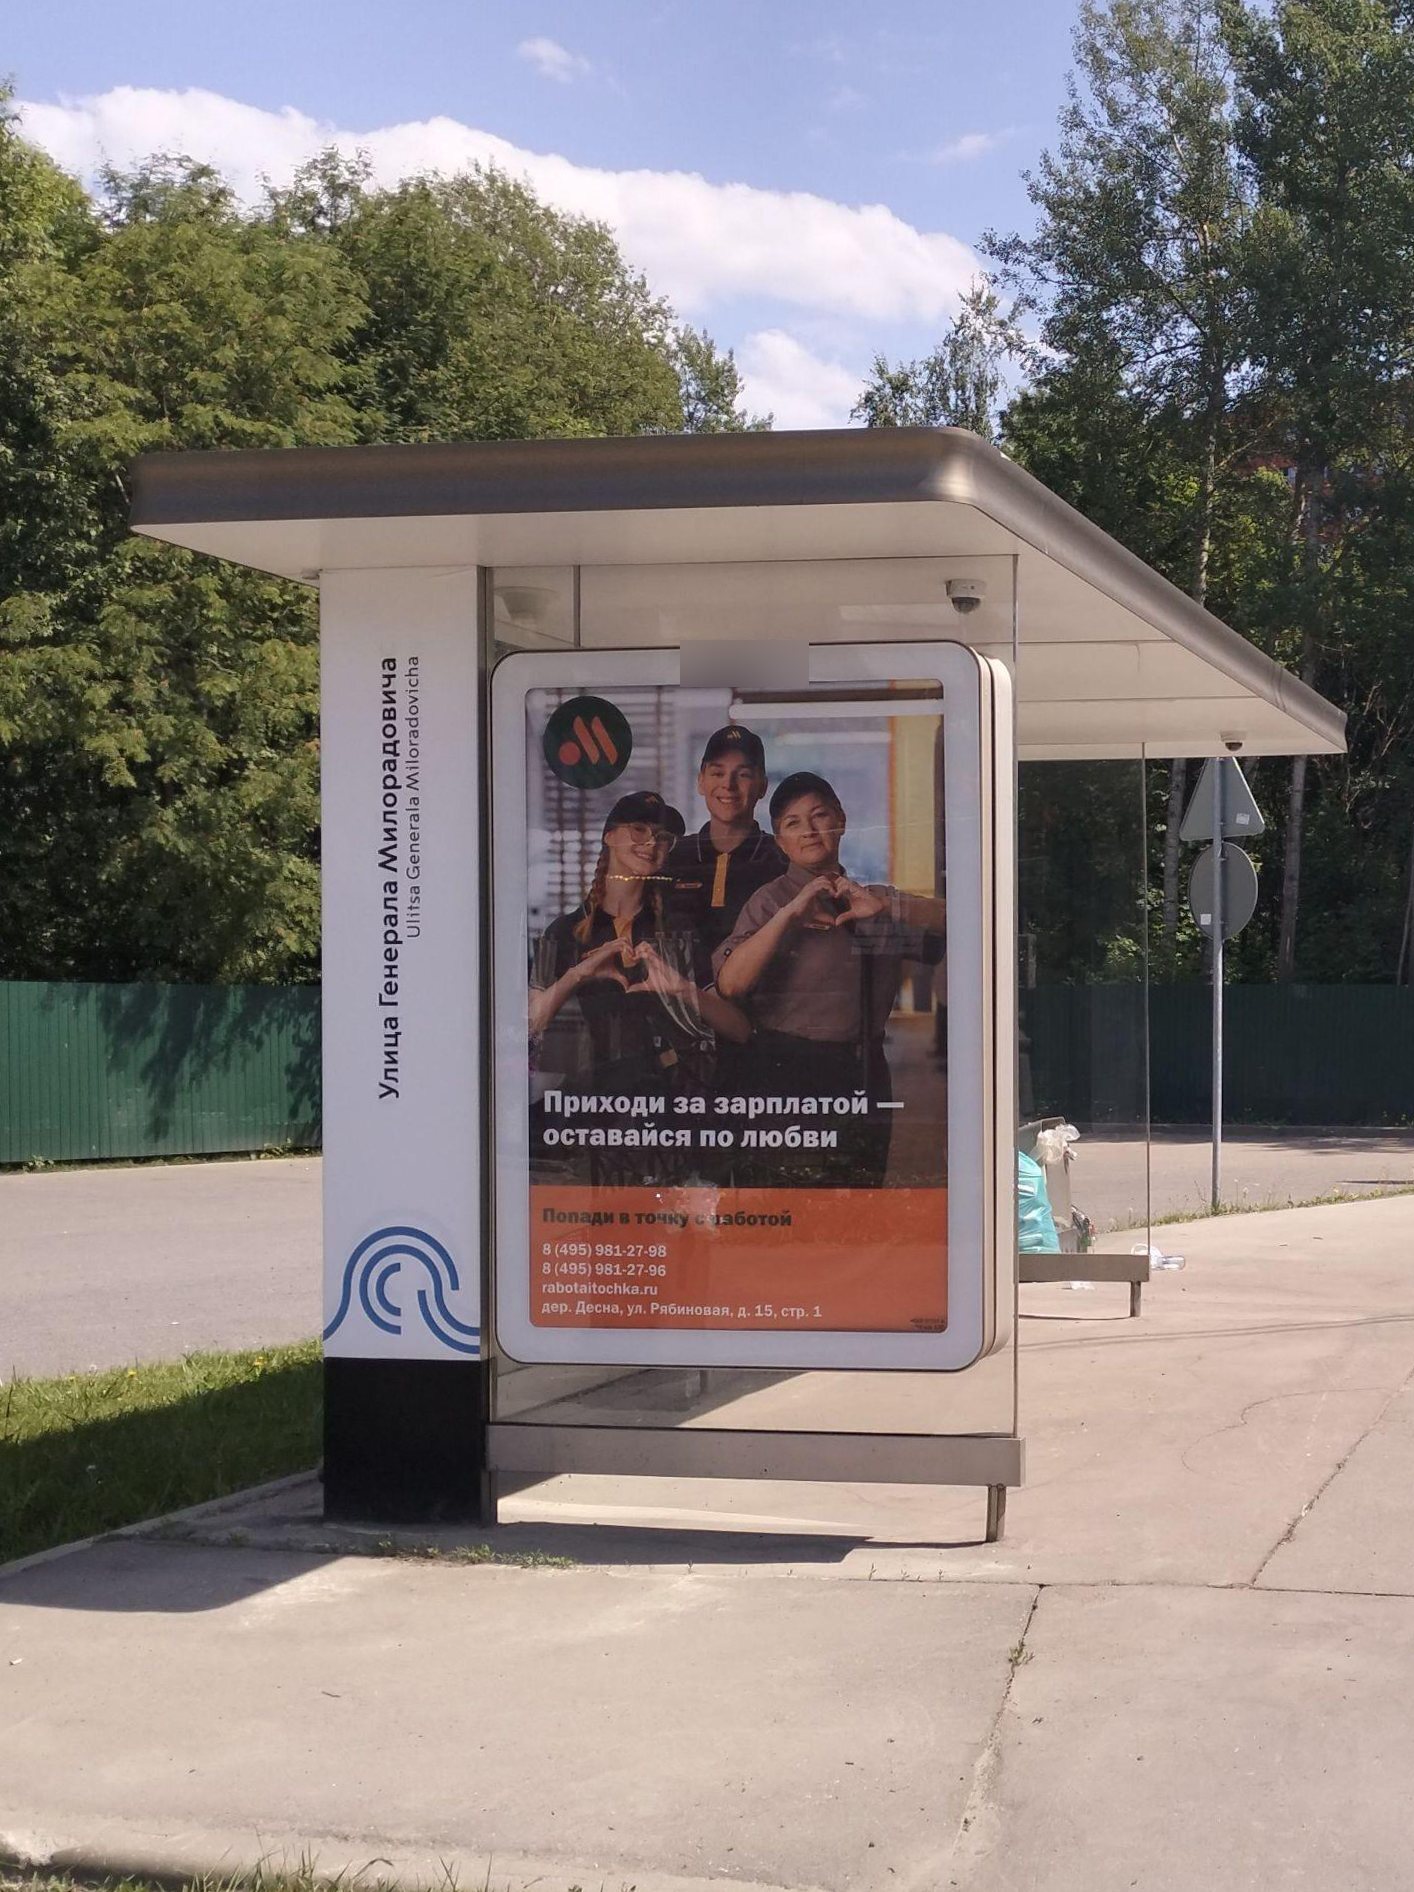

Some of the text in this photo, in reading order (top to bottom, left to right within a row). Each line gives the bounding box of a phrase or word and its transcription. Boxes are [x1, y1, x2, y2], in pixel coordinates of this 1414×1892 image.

[405, 656, 421, 938] Ulitsa Generala Miloradovicha
[377, 657, 403, 1099] Улица Генерала Милорадовича
[544, 1090, 665, 1118] Приходи
[673, 1096, 706, 1114] за
[714, 1090, 868, 1119] зарплатой
[543, 1122, 838, 1148] оставайся по любви
[542, 1208, 615, 1226] Попади
[619, 1213, 630, 1224] в
[635, 1213, 689, 1228] точку
[542, 1243, 667, 1258] 8 (495) 981-27-98
[542, 1262, 667, 1277] 8 (495) 981-27-96
[542, 1281, 658, 1296] rabotaitochka.ru
[541, 1301, 822, 1320] дер. Десна, ул. Рябиновая, д. 15, стр. 1
